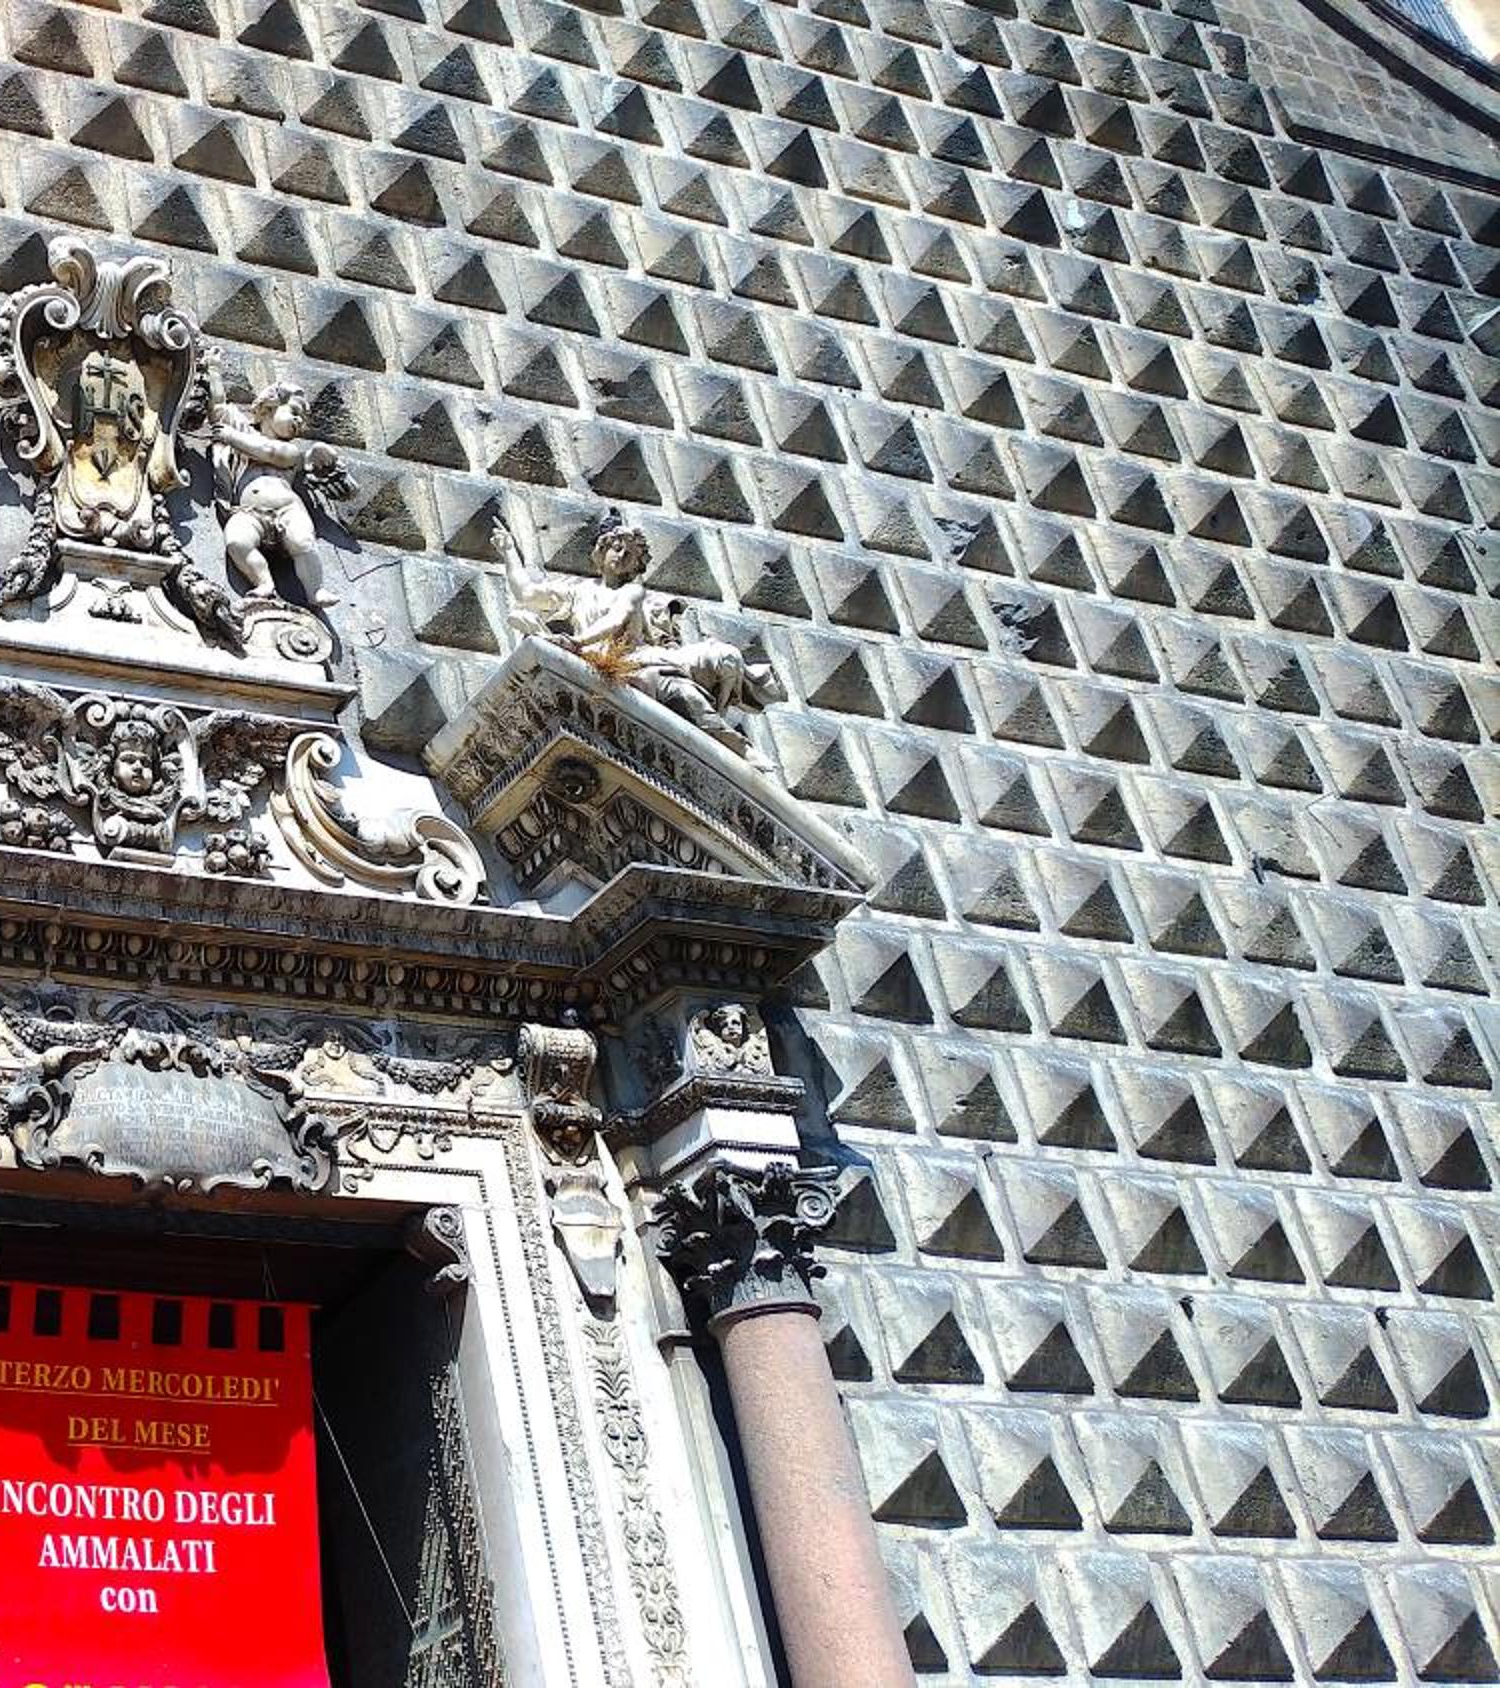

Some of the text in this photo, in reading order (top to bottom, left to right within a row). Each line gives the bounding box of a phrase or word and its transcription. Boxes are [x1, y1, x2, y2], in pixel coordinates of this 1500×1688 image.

[102, 1367, 280, 1402] MERCOLEDI'
[67, 1416, 213, 1449] DEL MESE
[174, 1489, 277, 1527] DEGLI
[37, 1533, 217, 1574] AMMALATI
[99, 1585, 160, 1614] con
